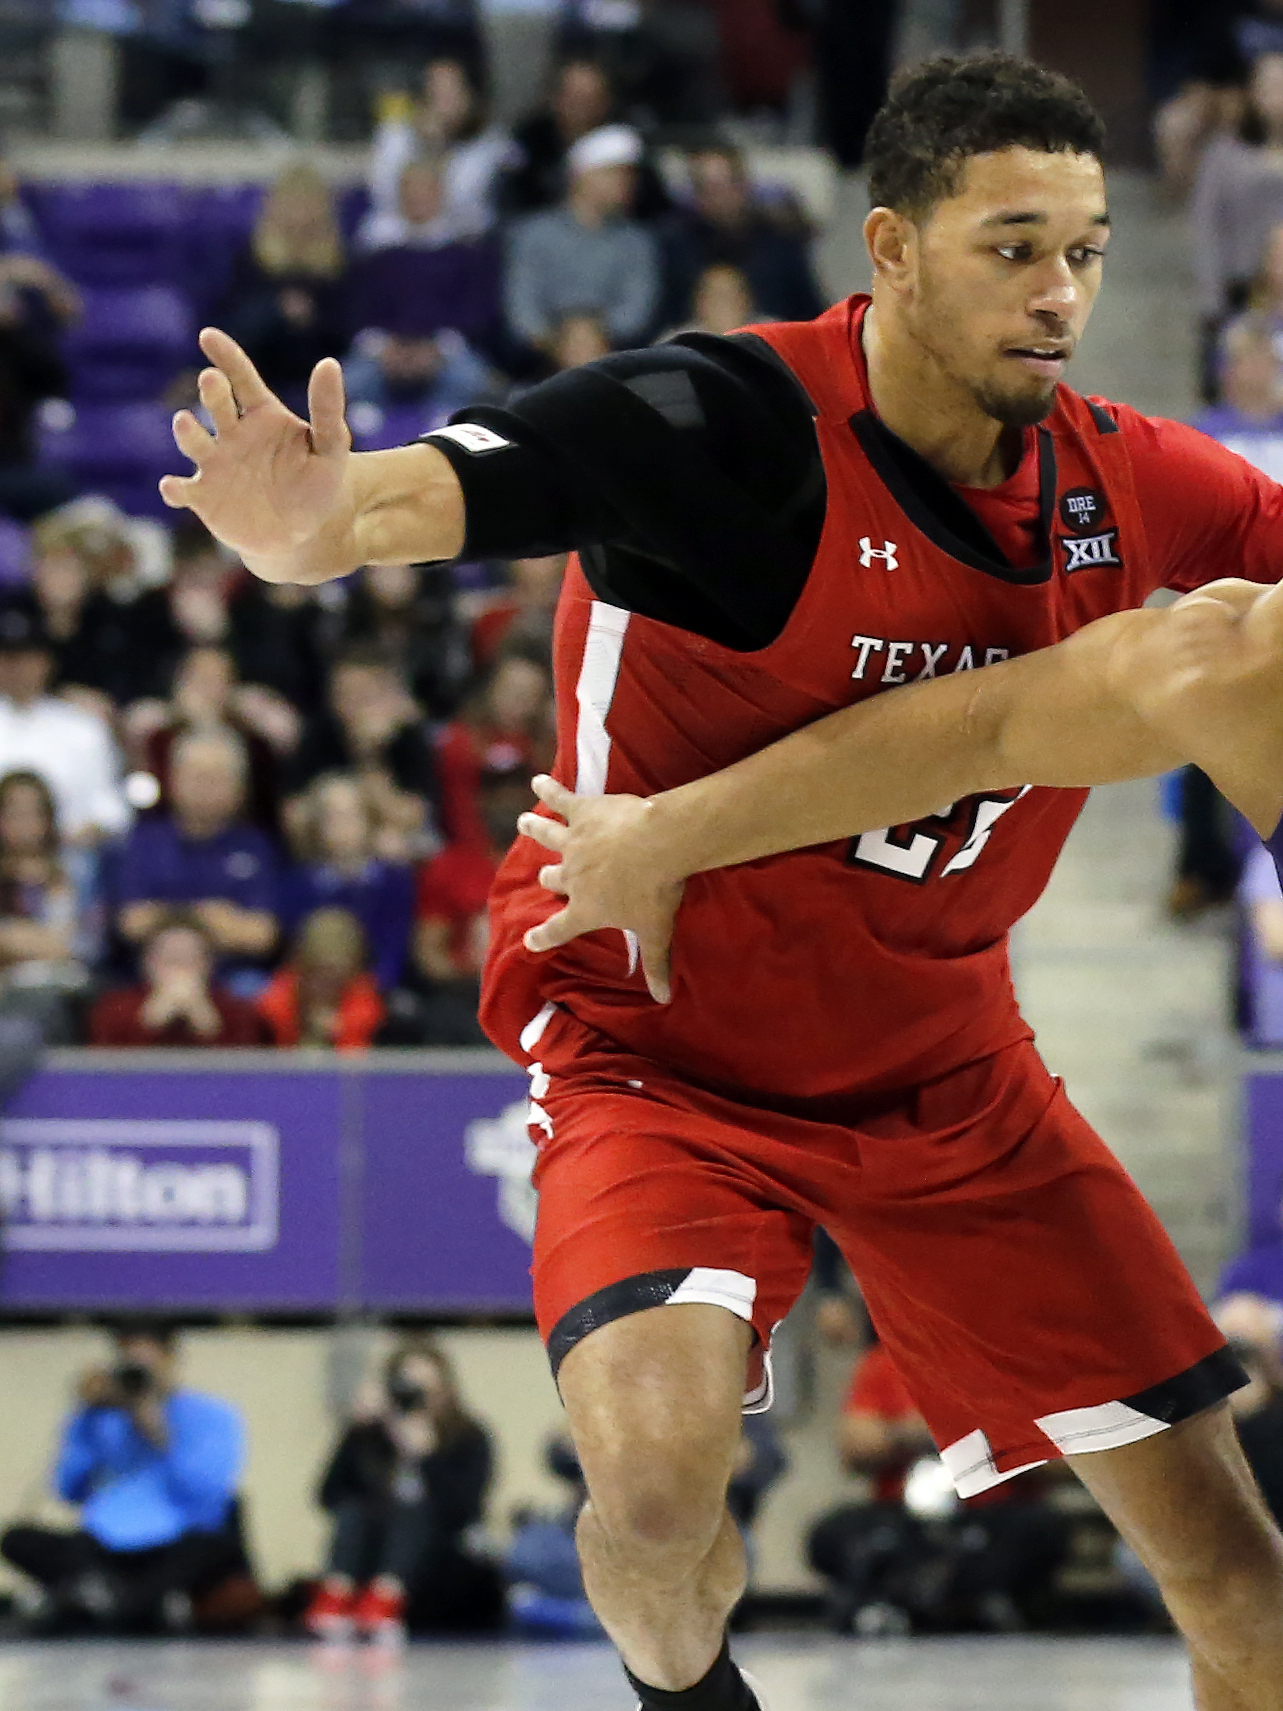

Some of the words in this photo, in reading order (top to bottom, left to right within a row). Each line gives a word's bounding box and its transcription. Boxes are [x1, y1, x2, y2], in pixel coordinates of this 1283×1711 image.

[1066, 495, 1097, 513] DRE
[1078, 511, 1091, 524] 14
[1063, 532, 1119, 571] XII
